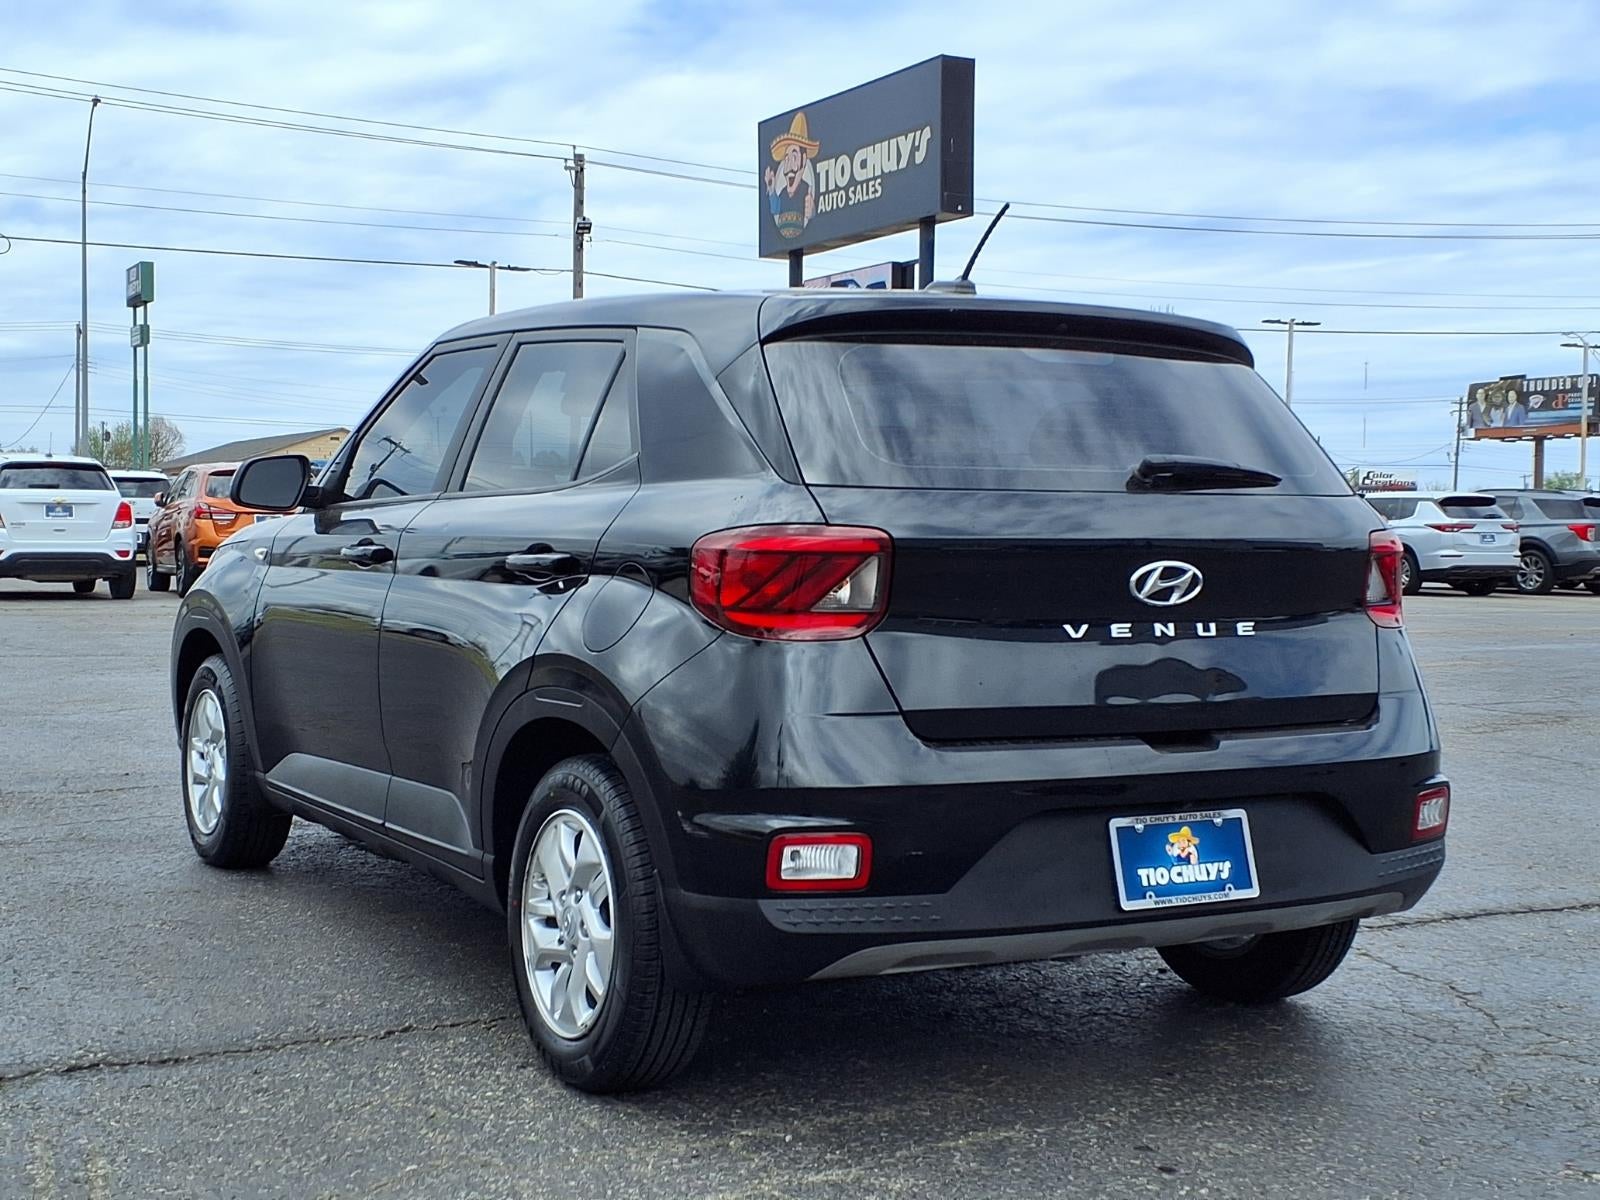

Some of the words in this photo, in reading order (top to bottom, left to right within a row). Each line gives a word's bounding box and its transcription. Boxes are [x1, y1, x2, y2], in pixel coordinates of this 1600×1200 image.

[817, 154, 851, 193] TIO
[852, 125, 932, 182] CHUY'S
[818, 192, 846, 214] AUTO
[848, 179, 882, 206] SALES
[1362, 476, 1416, 487] Creations
[1366, 471, 1394, 480] Color
[1062, 621, 1256, 639] VENUE
[1135, 816, 1148, 824] TIO
[1149, 815, 1177, 823] CHUY'S
[1137, 867, 1170, 887] TIO
[1170, 860, 1231, 884] CHUY'S
